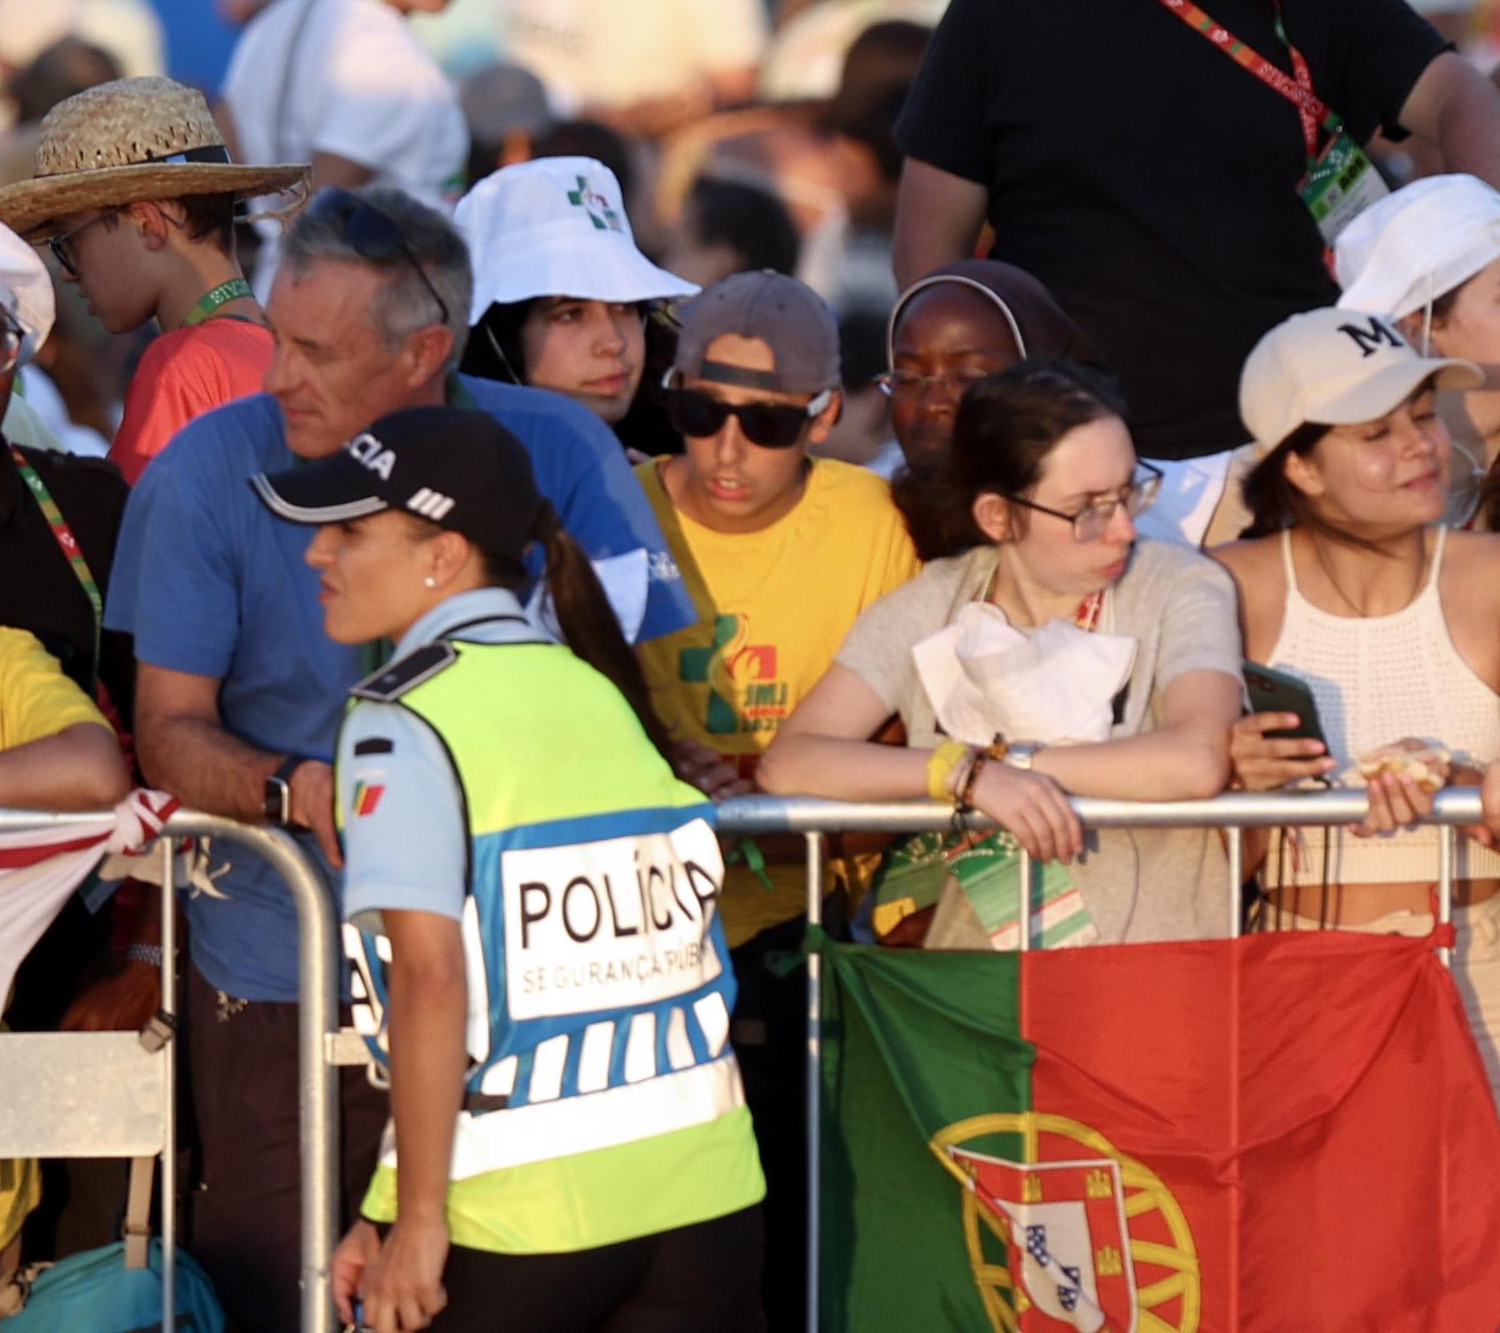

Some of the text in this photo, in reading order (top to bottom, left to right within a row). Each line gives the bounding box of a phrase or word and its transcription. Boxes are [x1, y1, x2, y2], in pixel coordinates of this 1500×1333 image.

[1336, 316, 1404, 358] M
[345, 432, 396, 481] CIA
[519, 849, 719, 954] POLÍCIA
